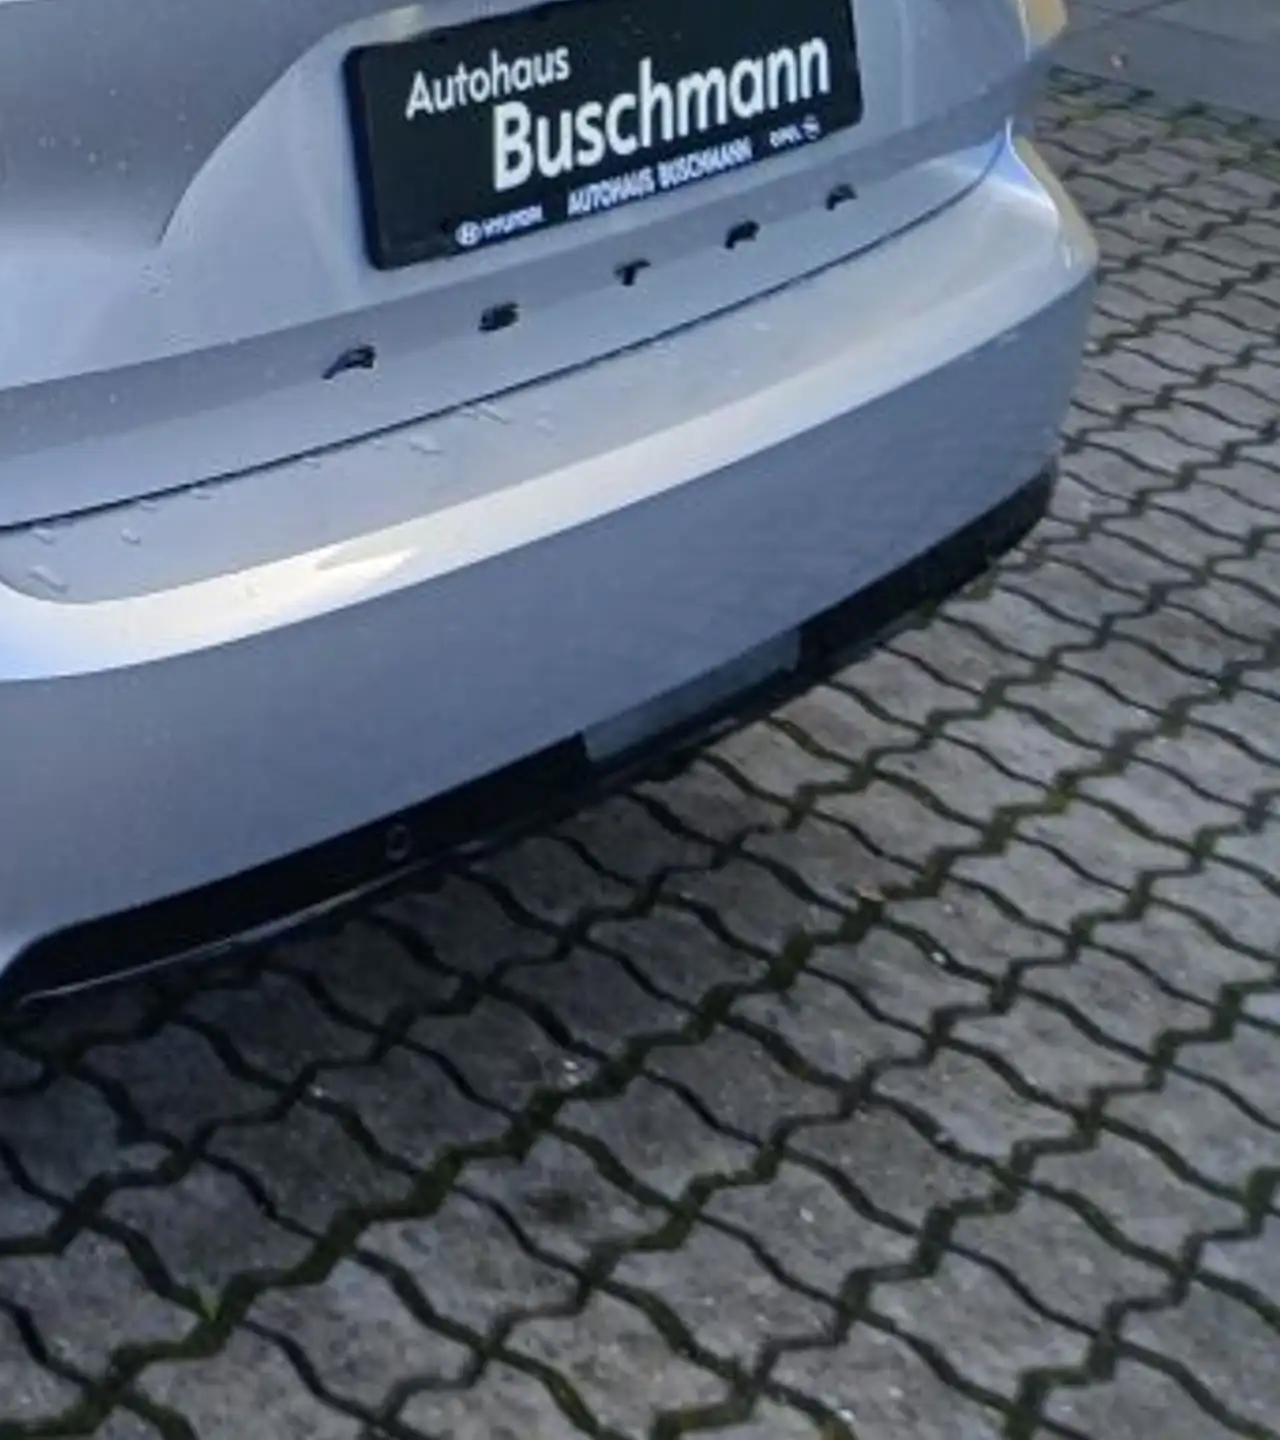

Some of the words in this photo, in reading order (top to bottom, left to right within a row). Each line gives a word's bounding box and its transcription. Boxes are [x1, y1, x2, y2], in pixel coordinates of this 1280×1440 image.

[405, 45, 569, 118] Autohaus
[493, 38, 829, 192] Buschmann
[567, 166, 655, 215] AUTOHAUS
[657, 135, 753, 189] BUSCHMANN
